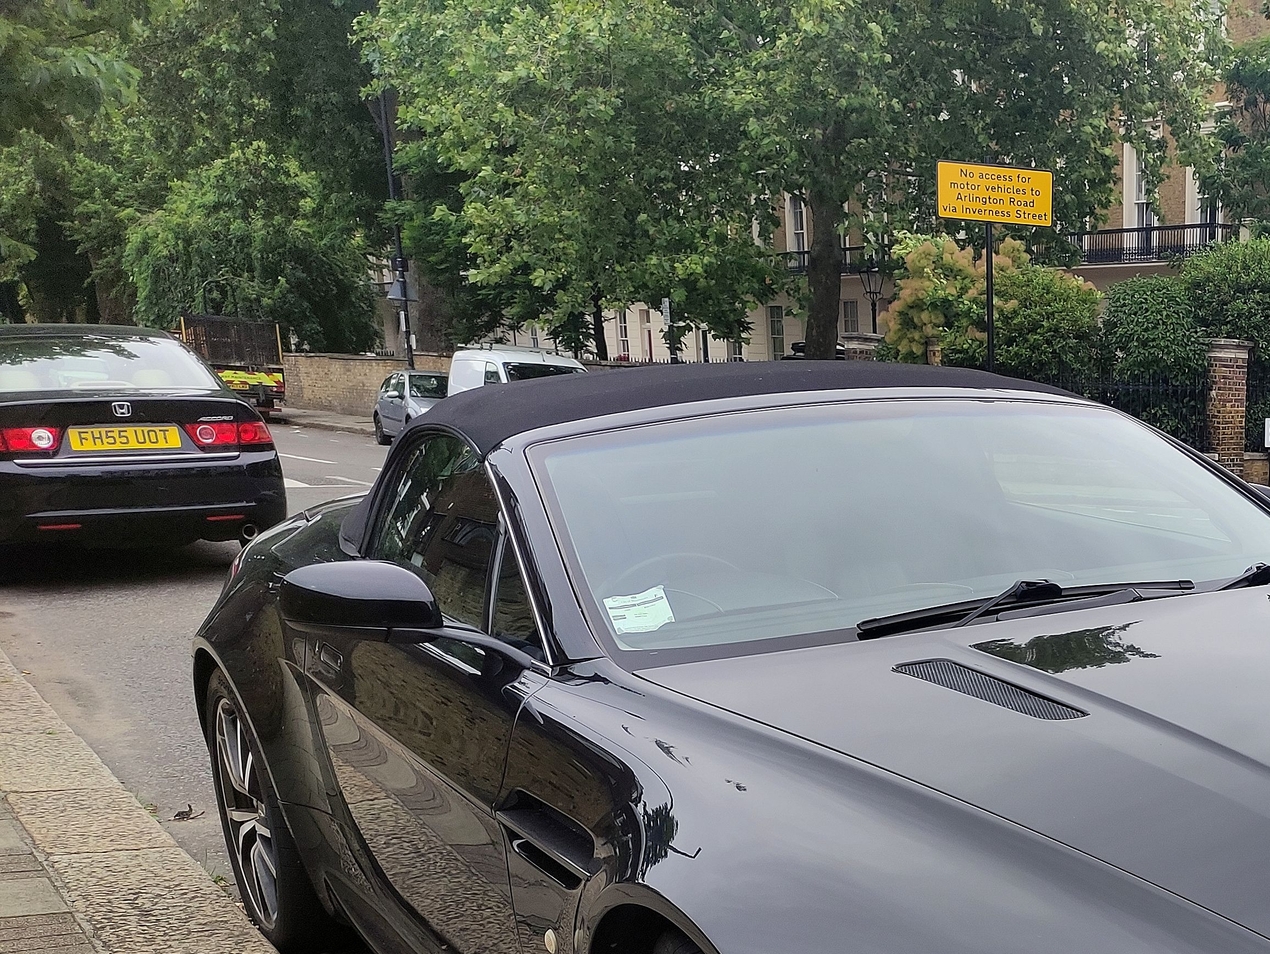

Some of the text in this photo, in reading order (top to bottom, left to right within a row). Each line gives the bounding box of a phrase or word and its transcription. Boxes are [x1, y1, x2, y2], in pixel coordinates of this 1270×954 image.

[960, 168, 1031, 184] No access for
[949, 181, 1041, 197] motor vehicles to
[955, 192, 1035, 208] Arlington Road
[942, 203, 1048, 221] via Inverness Street
[78, 428, 170, 447] FH55 UOT
